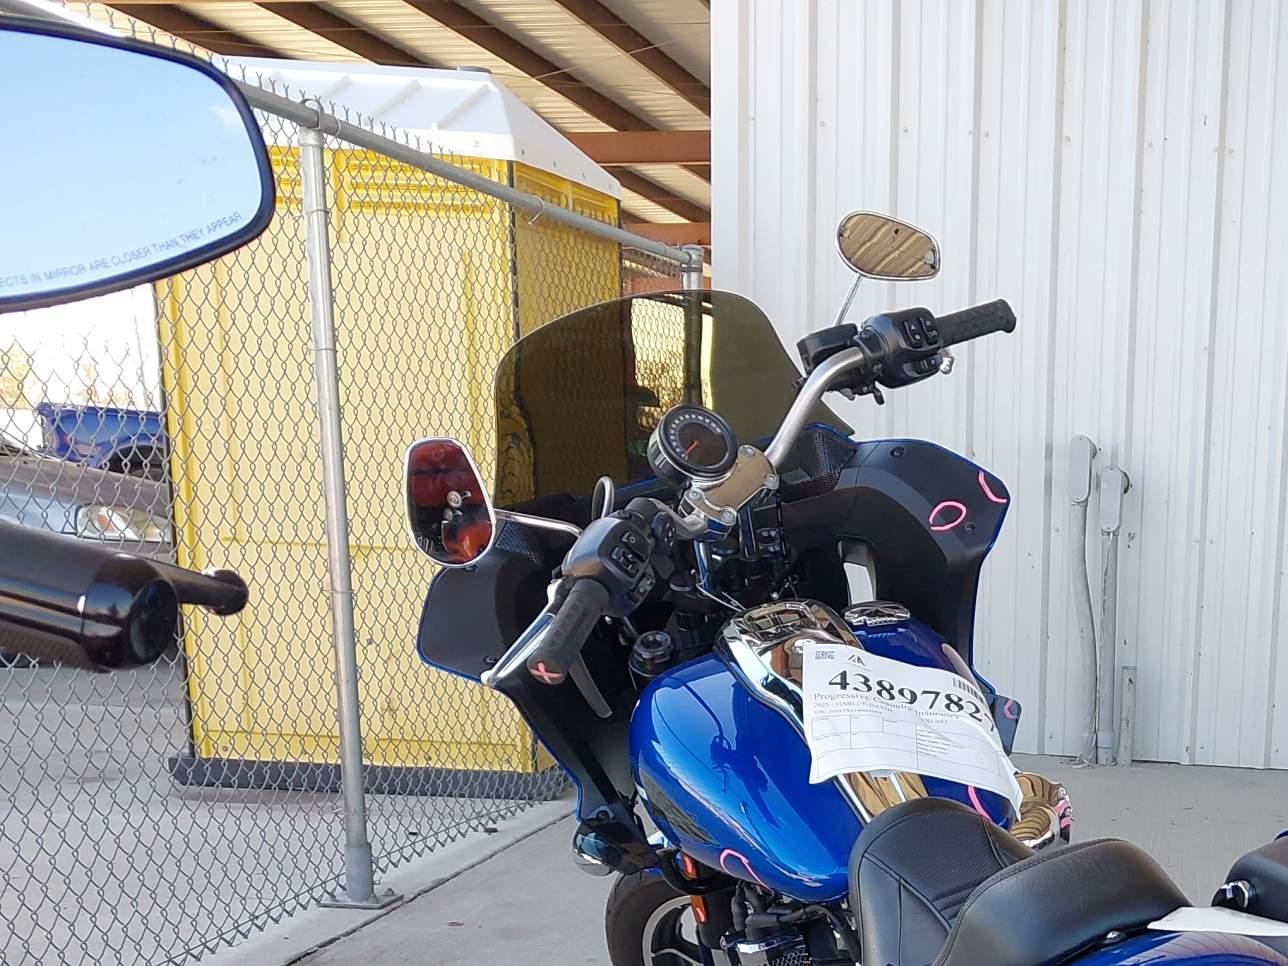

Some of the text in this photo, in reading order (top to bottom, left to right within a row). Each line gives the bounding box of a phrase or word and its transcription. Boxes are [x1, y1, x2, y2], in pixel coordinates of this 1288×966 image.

[30, 271, 42, 283] IN
[43, 263, 87, 281] MIRROR
[88, 258, 112, 272] ARE
[110, 247, 152, 264] CLOSER
[152, 237, 179, 252] THAN
[179, 228, 205, 244] THEY
[206, 211, 244, 235] APPEAR
[828, 670, 995, 732] 43897827
